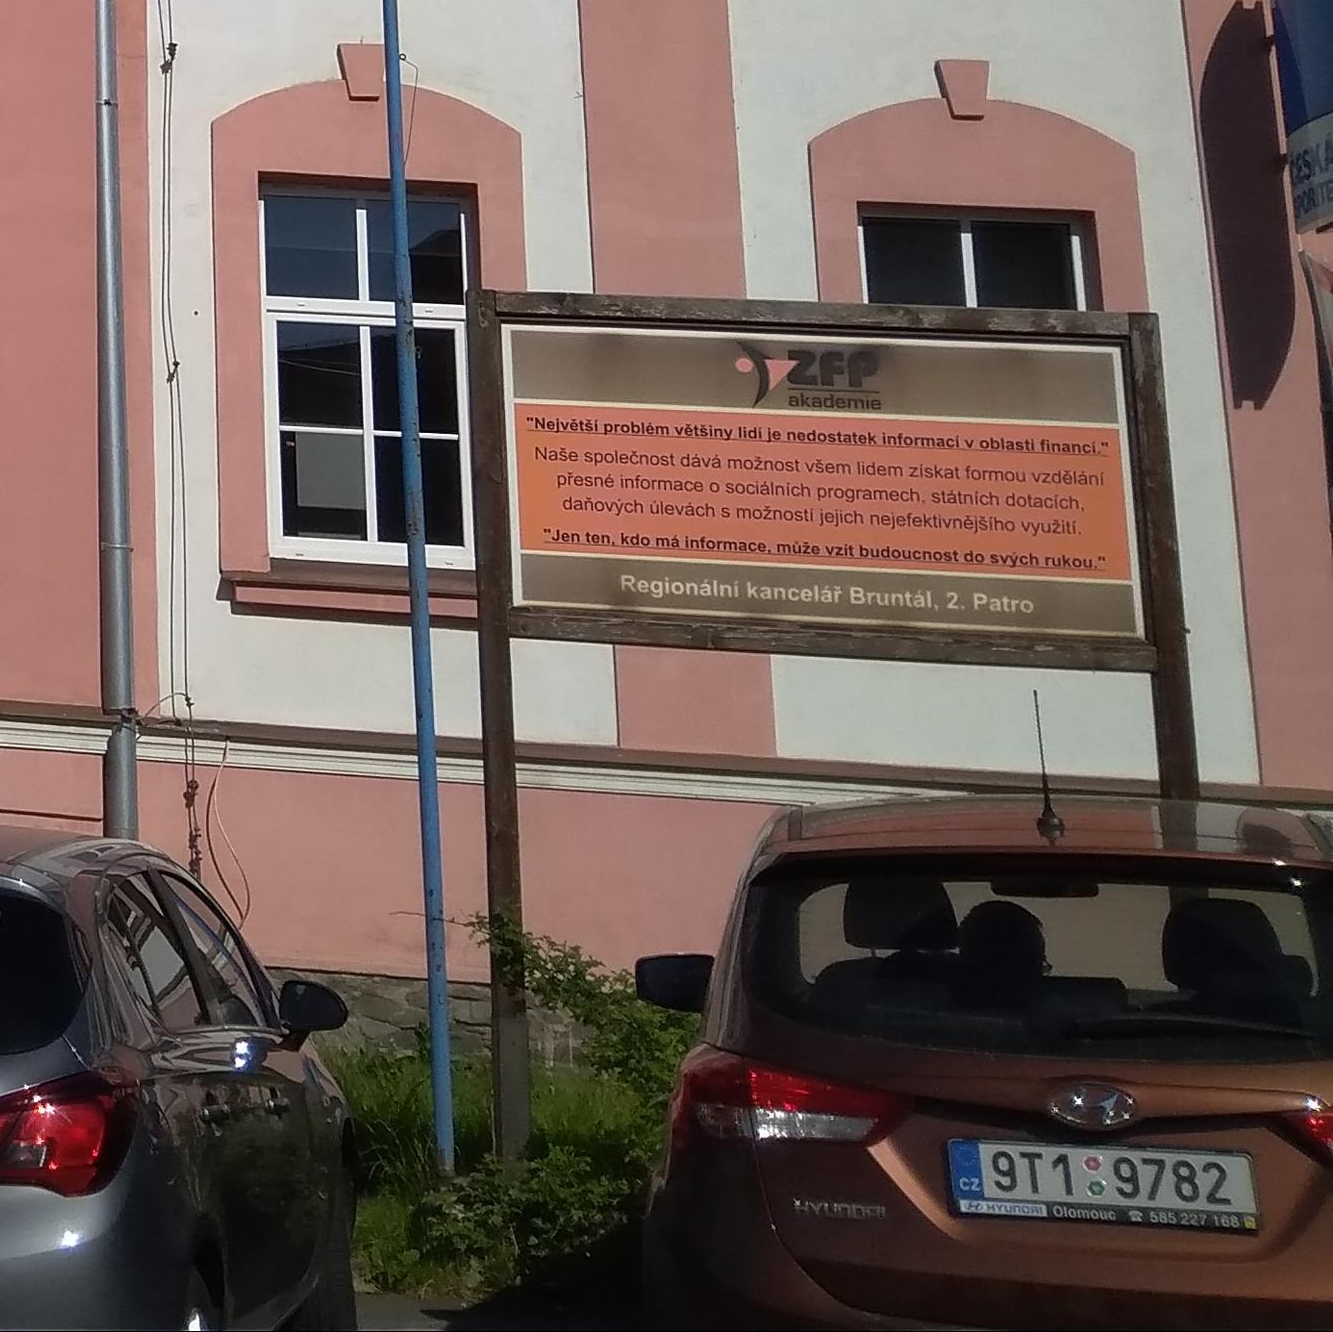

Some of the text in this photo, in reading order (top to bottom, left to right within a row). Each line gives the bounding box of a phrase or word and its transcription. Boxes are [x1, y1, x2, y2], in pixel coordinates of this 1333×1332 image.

[787, 349, 881, 388] ZFP
[789, 393, 881, 410] akademie
[527, 416, 598, 434] "Největší
[604, 419, 669, 438] problém
[675, 423, 732, 441] většiny
[739, 426, 762, 440] lidí
[767, 428, 781, 442] je
[787, 429, 876, 445] nedostatek
[883, 433, 959, 448] informací
[965, 439, 974, 448] v
[980, 437, 1033, 452] oblasti
[535, 446, 1104, 485] Naše společnost dává možnost všem lidem získat formou vzdělání
[557, 472, 1084, 511] přesné informace o sociálních programech, státních dotacích,
[562, 496, 1081, 537] daňových úlevách s možností jejich nejefektivnějšího využití.
[544, 528, 580, 543] "Jen
[585, 532, 615, 547] ten,
[620, 532, 649, 547] kdo
[656, 535, 679, 548] má
[777, 539, 820, 555] může
[825, 543, 854, 557] vzít
[859, 545, 958, 562] budoucnost
[964, 549, 984, 563] do
[990, 552, 1039, 569] svých
[620, 574, 1034, 613] Regionální kancelář Bruntál, 2. Patro
[959, 1177, 980, 1191] CZ
[992, 1151, 1231, 1205] 9T1 9782
[986, 1203, 1043, 1214] HYUNDAI
[1053, 1205, 1116, 1221] Olomouc
[1150, 1211, 1176, 1224] 585
[1180, 1213, 1207, 1225] 227
